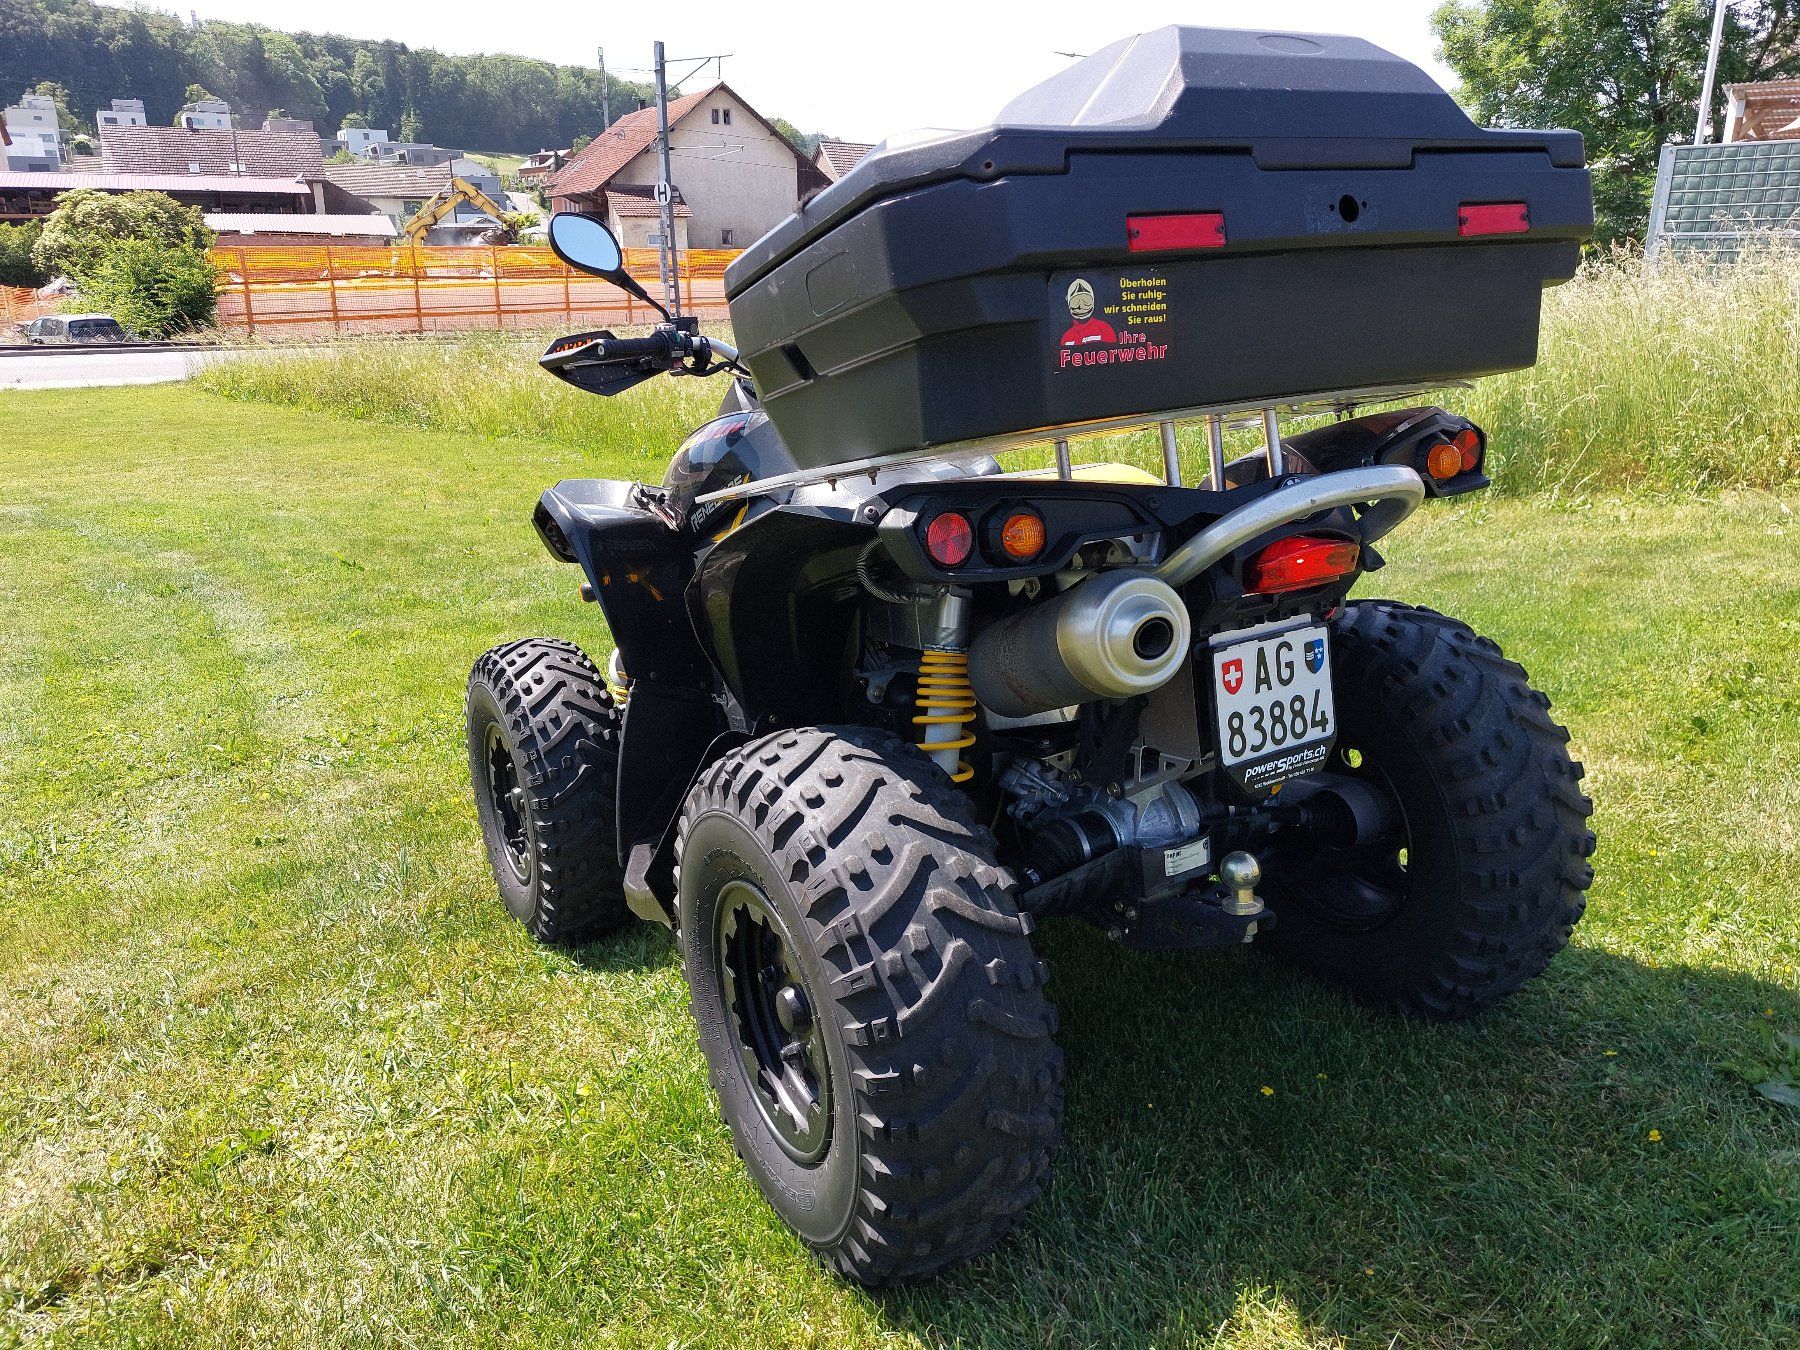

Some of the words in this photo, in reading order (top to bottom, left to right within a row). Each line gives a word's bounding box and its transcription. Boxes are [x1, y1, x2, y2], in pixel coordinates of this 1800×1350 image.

[658, 184, 667, 202] H
[1119, 278, 1167, 288] Überholen
[1121, 291, 1136, 300] Sie
[1138, 290, 1167, 300] ruhig-
[1104, 305, 1119, 314] wir
[1122, 302, 1167, 313] schneiden
[1127, 316, 1141, 325] Sie
[1144, 314, 1166, 324] raus!
[1119, 331, 1146, 344] Ihre
[1060, 342, 1168, 367] Feuerwehr
[1255, 641, 1295, 694] AG
[1227, 688, 1329, 758] 83884
[1244, 744, 1326, 783] powerSports.ch
